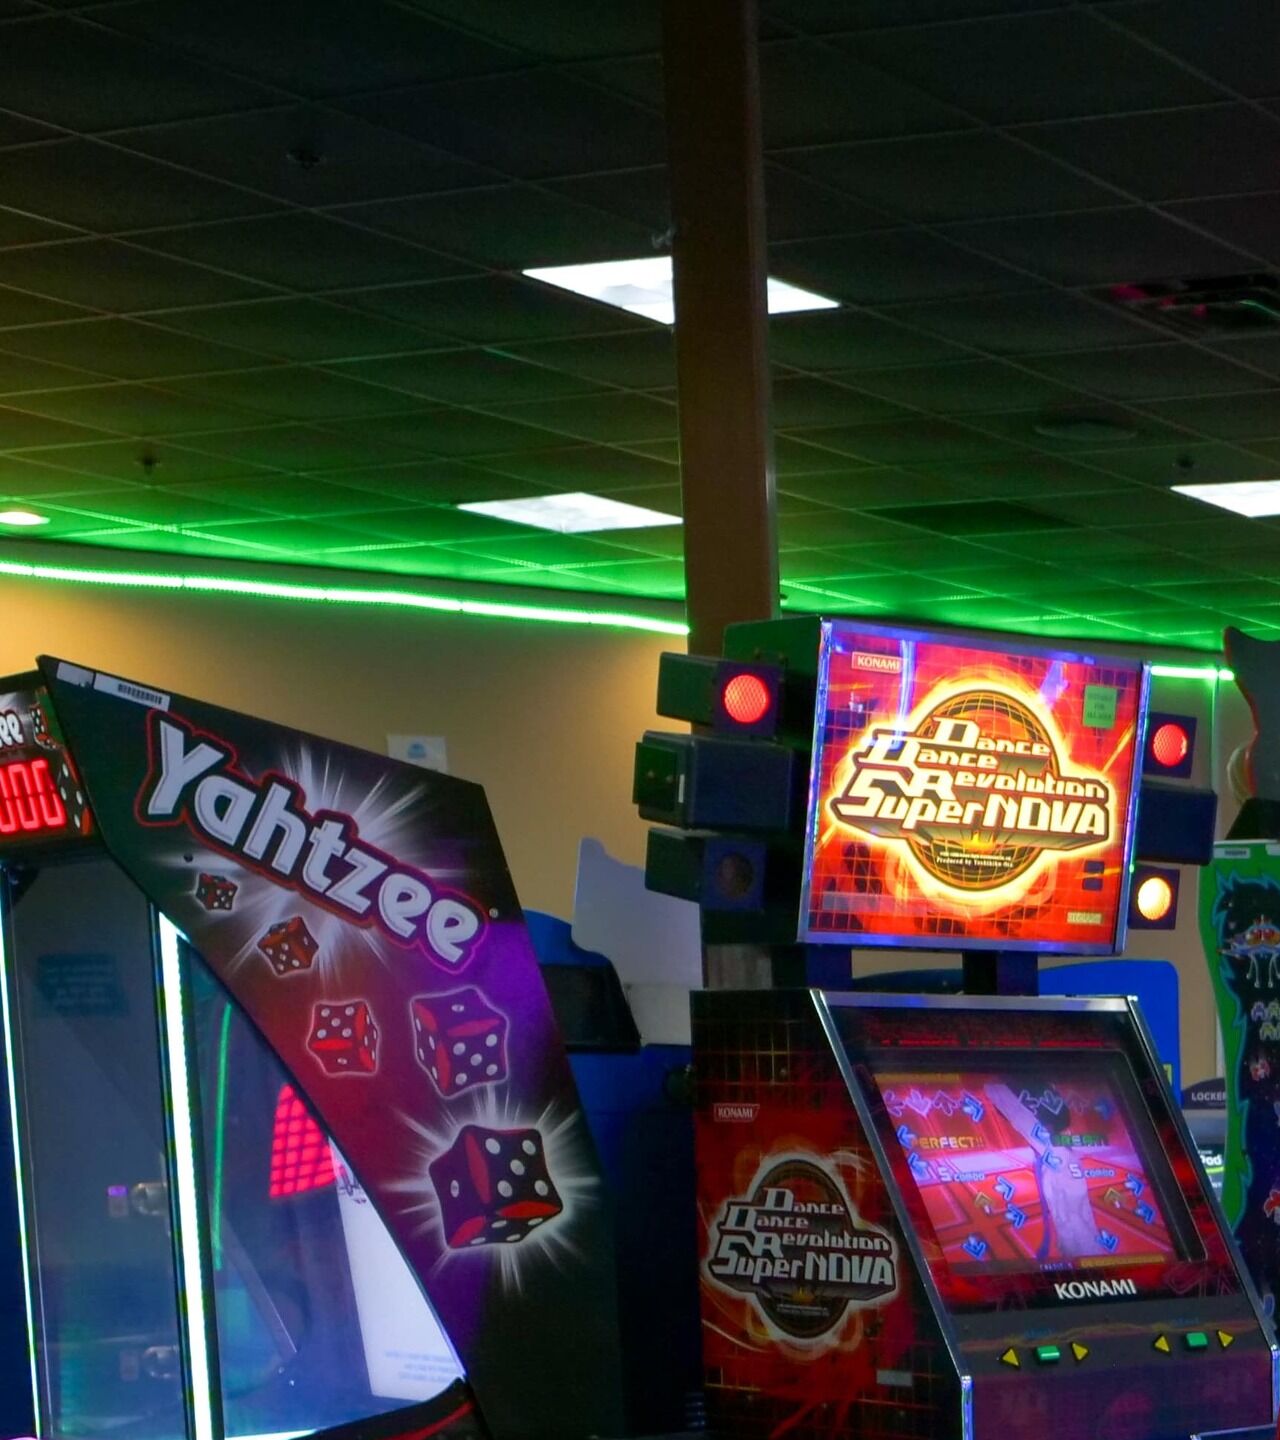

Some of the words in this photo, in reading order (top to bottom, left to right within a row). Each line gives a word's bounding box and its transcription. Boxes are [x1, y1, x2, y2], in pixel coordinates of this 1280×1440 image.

[857, 656, 900, 671] KONAMI
[933, 716, 1050, 757] Dance
[859, 734, 998, 770] Dance
[911, 767, 1106, 800] Revolution
[838, 768, 1106, 837] SuperNOVA
[148, 719, 481, 964] Yahtzee
[717, 1107, 754, 1119] KONAMI
[763, 1188, 846, 1215] Dance
[720, 1205, 809, 1232] Dance
[751, 1230, 890, 1258] Revolution
[712, 1234, 894, 1287] SuperNOVA
[1055, 1279, 1138, 1300] KONAMI
